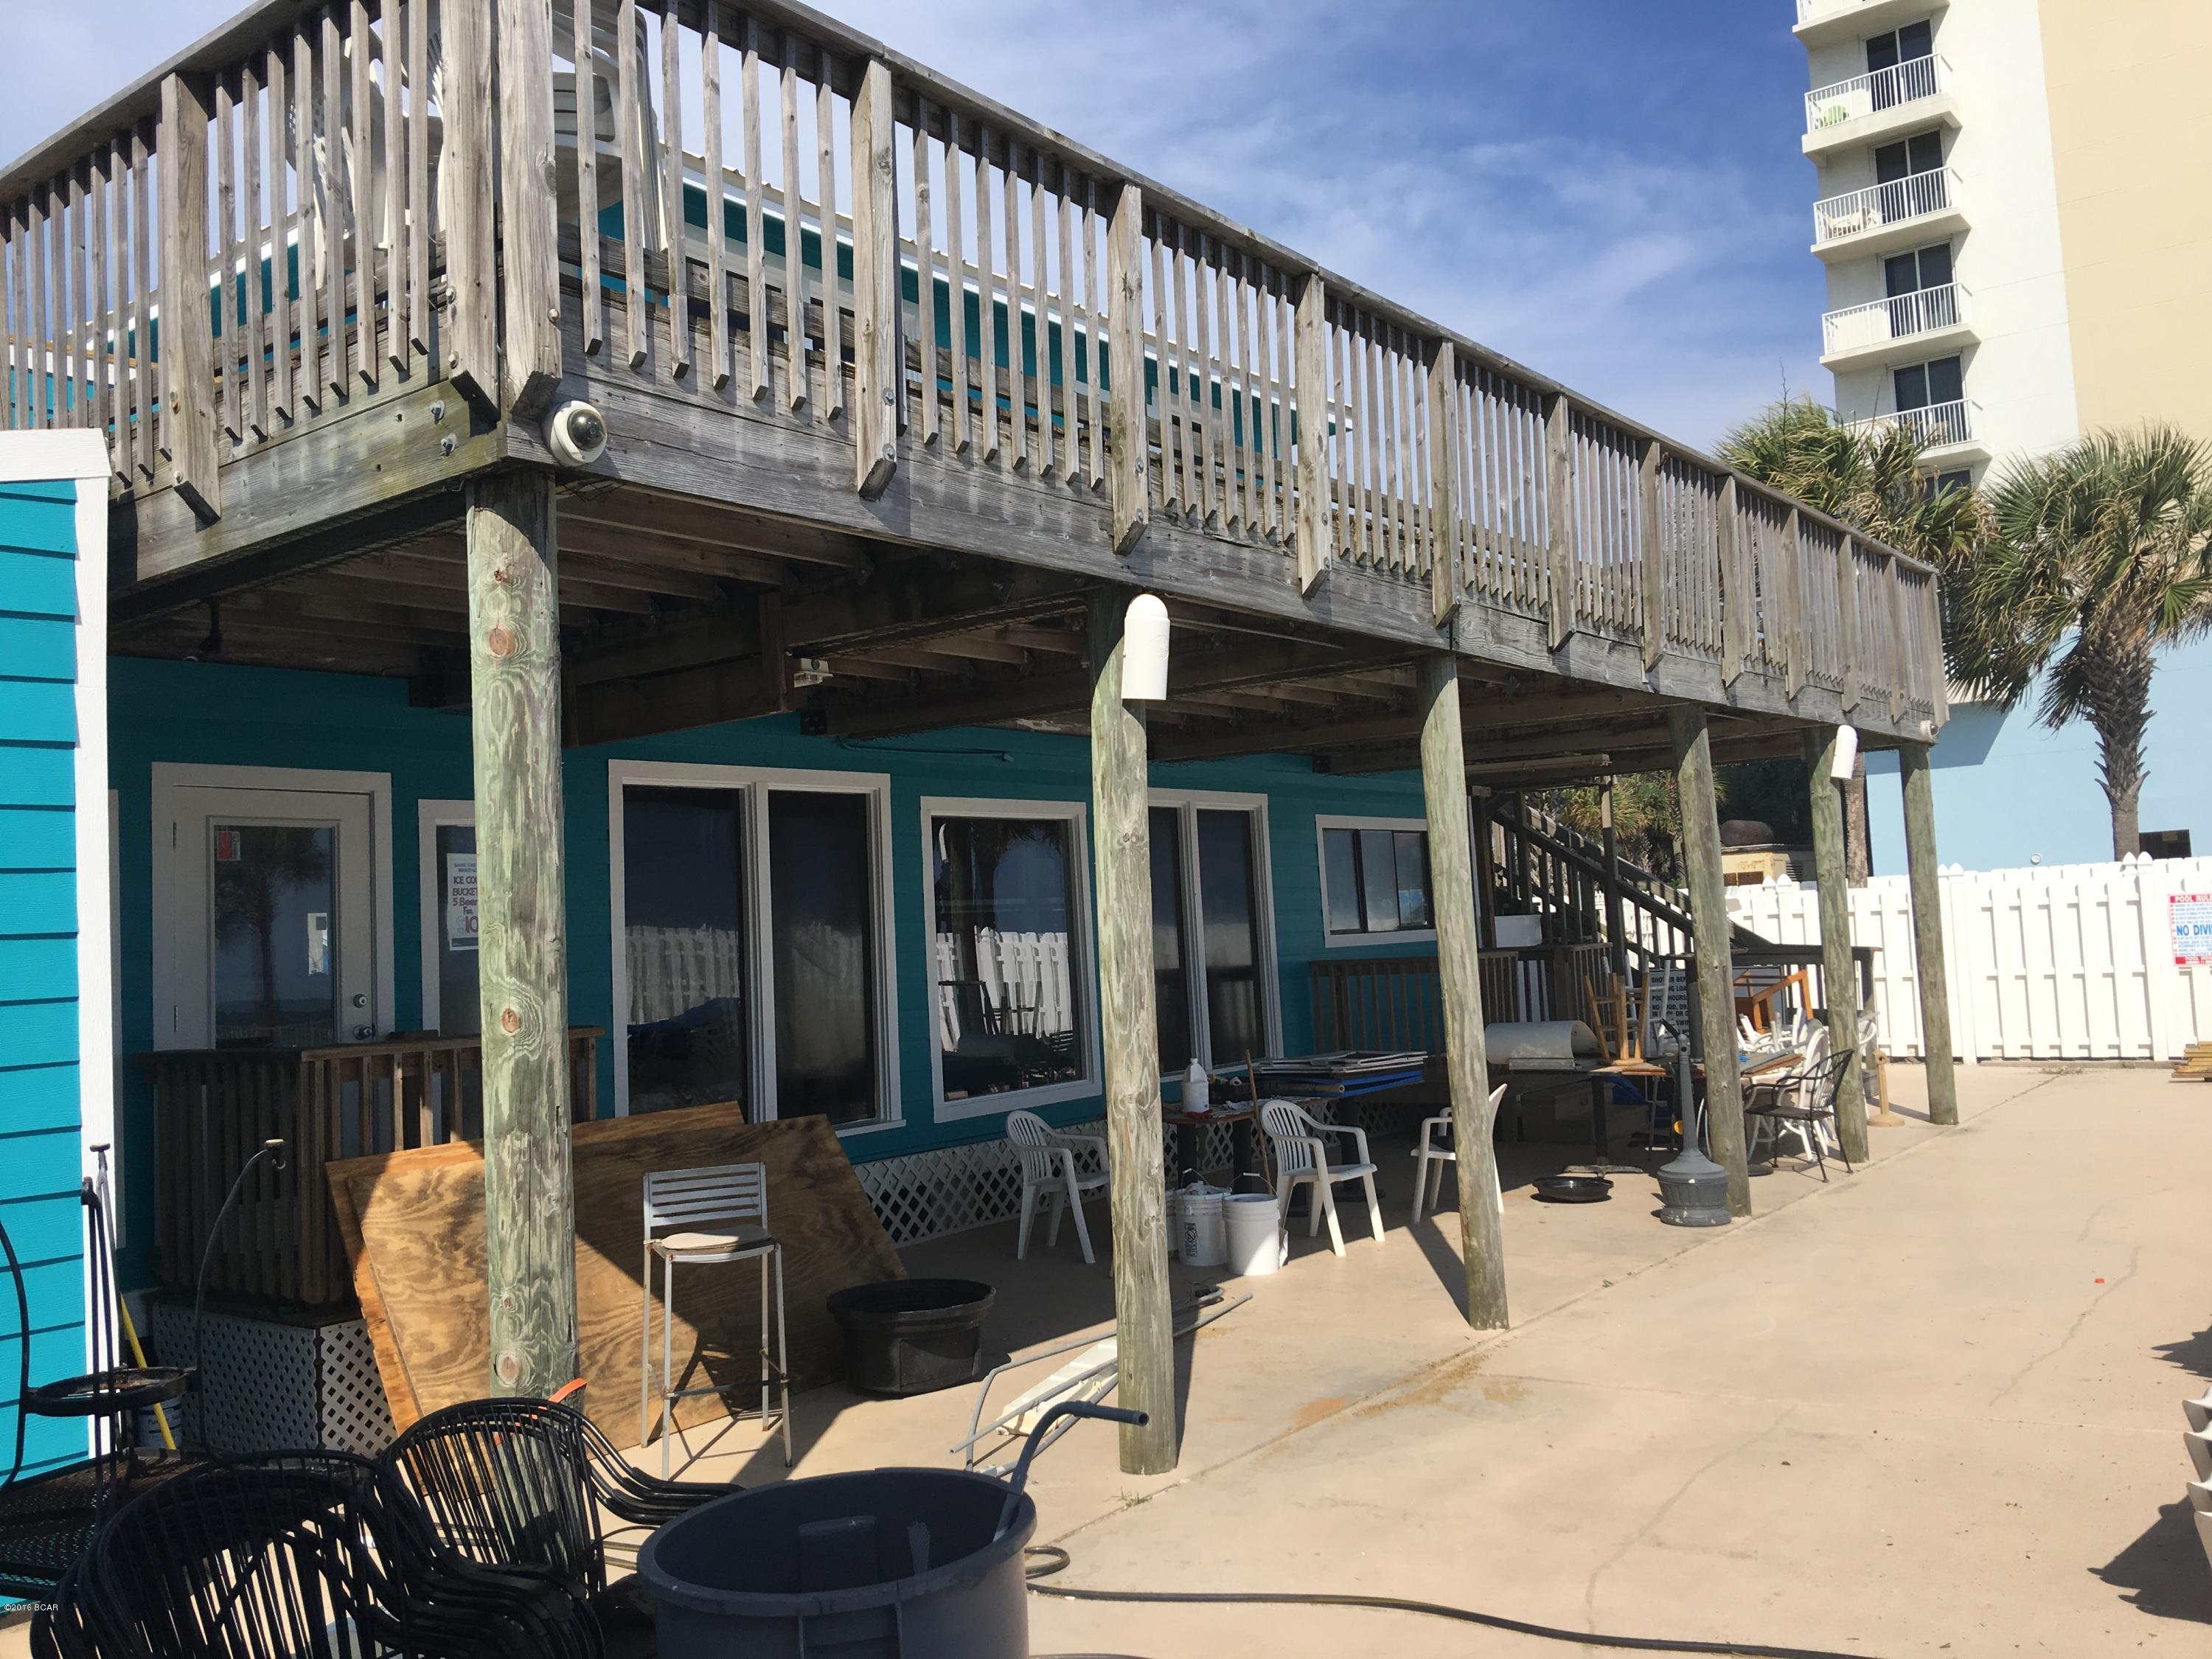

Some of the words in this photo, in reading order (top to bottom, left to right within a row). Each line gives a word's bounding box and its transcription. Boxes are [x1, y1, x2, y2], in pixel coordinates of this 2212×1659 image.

[453, 876, 465, 884] ICE
[453, 897, 458, 906] 5
[2177, 925, 2190, 936] NO
